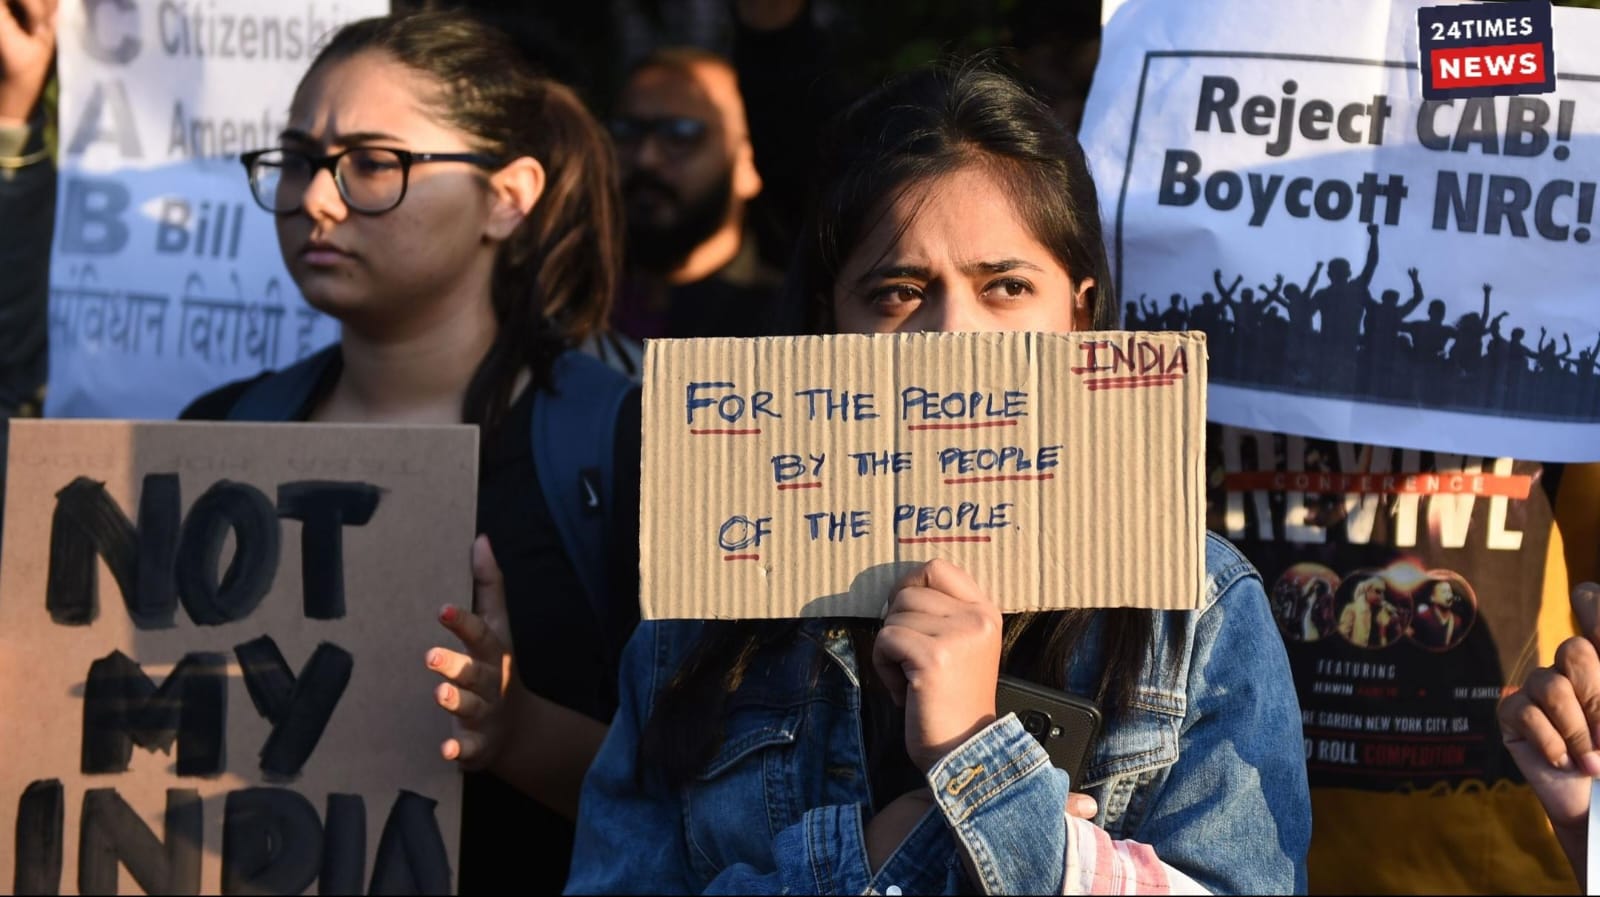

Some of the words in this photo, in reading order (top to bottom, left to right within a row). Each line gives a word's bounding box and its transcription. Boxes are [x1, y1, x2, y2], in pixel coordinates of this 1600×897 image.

[67, 79, 145, 158] A
[1195, 75, 1392, 157] Reject
[1416, 97, 1576, 161] CAB!
[1158, 149, 1408, 228] Boycott
[1432, 170, 1598, 244] NRC!
[60, 179, 131, 255] B
[155, 196, 245, 260] Bill
[1071, 336, 1188, 374] INDIA
[686, 382, 782, 424] FOR
[795, 390, 881, 421] THE
[902, 387, 1029, 420] PEOPLE
[771, 453, 826, 483] BY
[848, 452, 912, 476] THE
[940, 445, 1065, 474] PEOPLE
[1275, 474, 1485, 492] CONFERENCE
[46, 472, 391, 630] NOT
[718, 516, 772, 552] OF
[805, 509, 871, 543] THE
[1317, 660, 1396, 679] FEATURING
[81, 634, 354, 783] MY
[1319, 712, 1363, 728] GARDEN
[1366, 717, 1391, 731] NEW
[1394, 717, 1422, 732] YORK
[1452, 717, 1469, 732] USA
[1318, 741, 1358, 764] ROLL
[14, 778, 454, 896] INDIA
